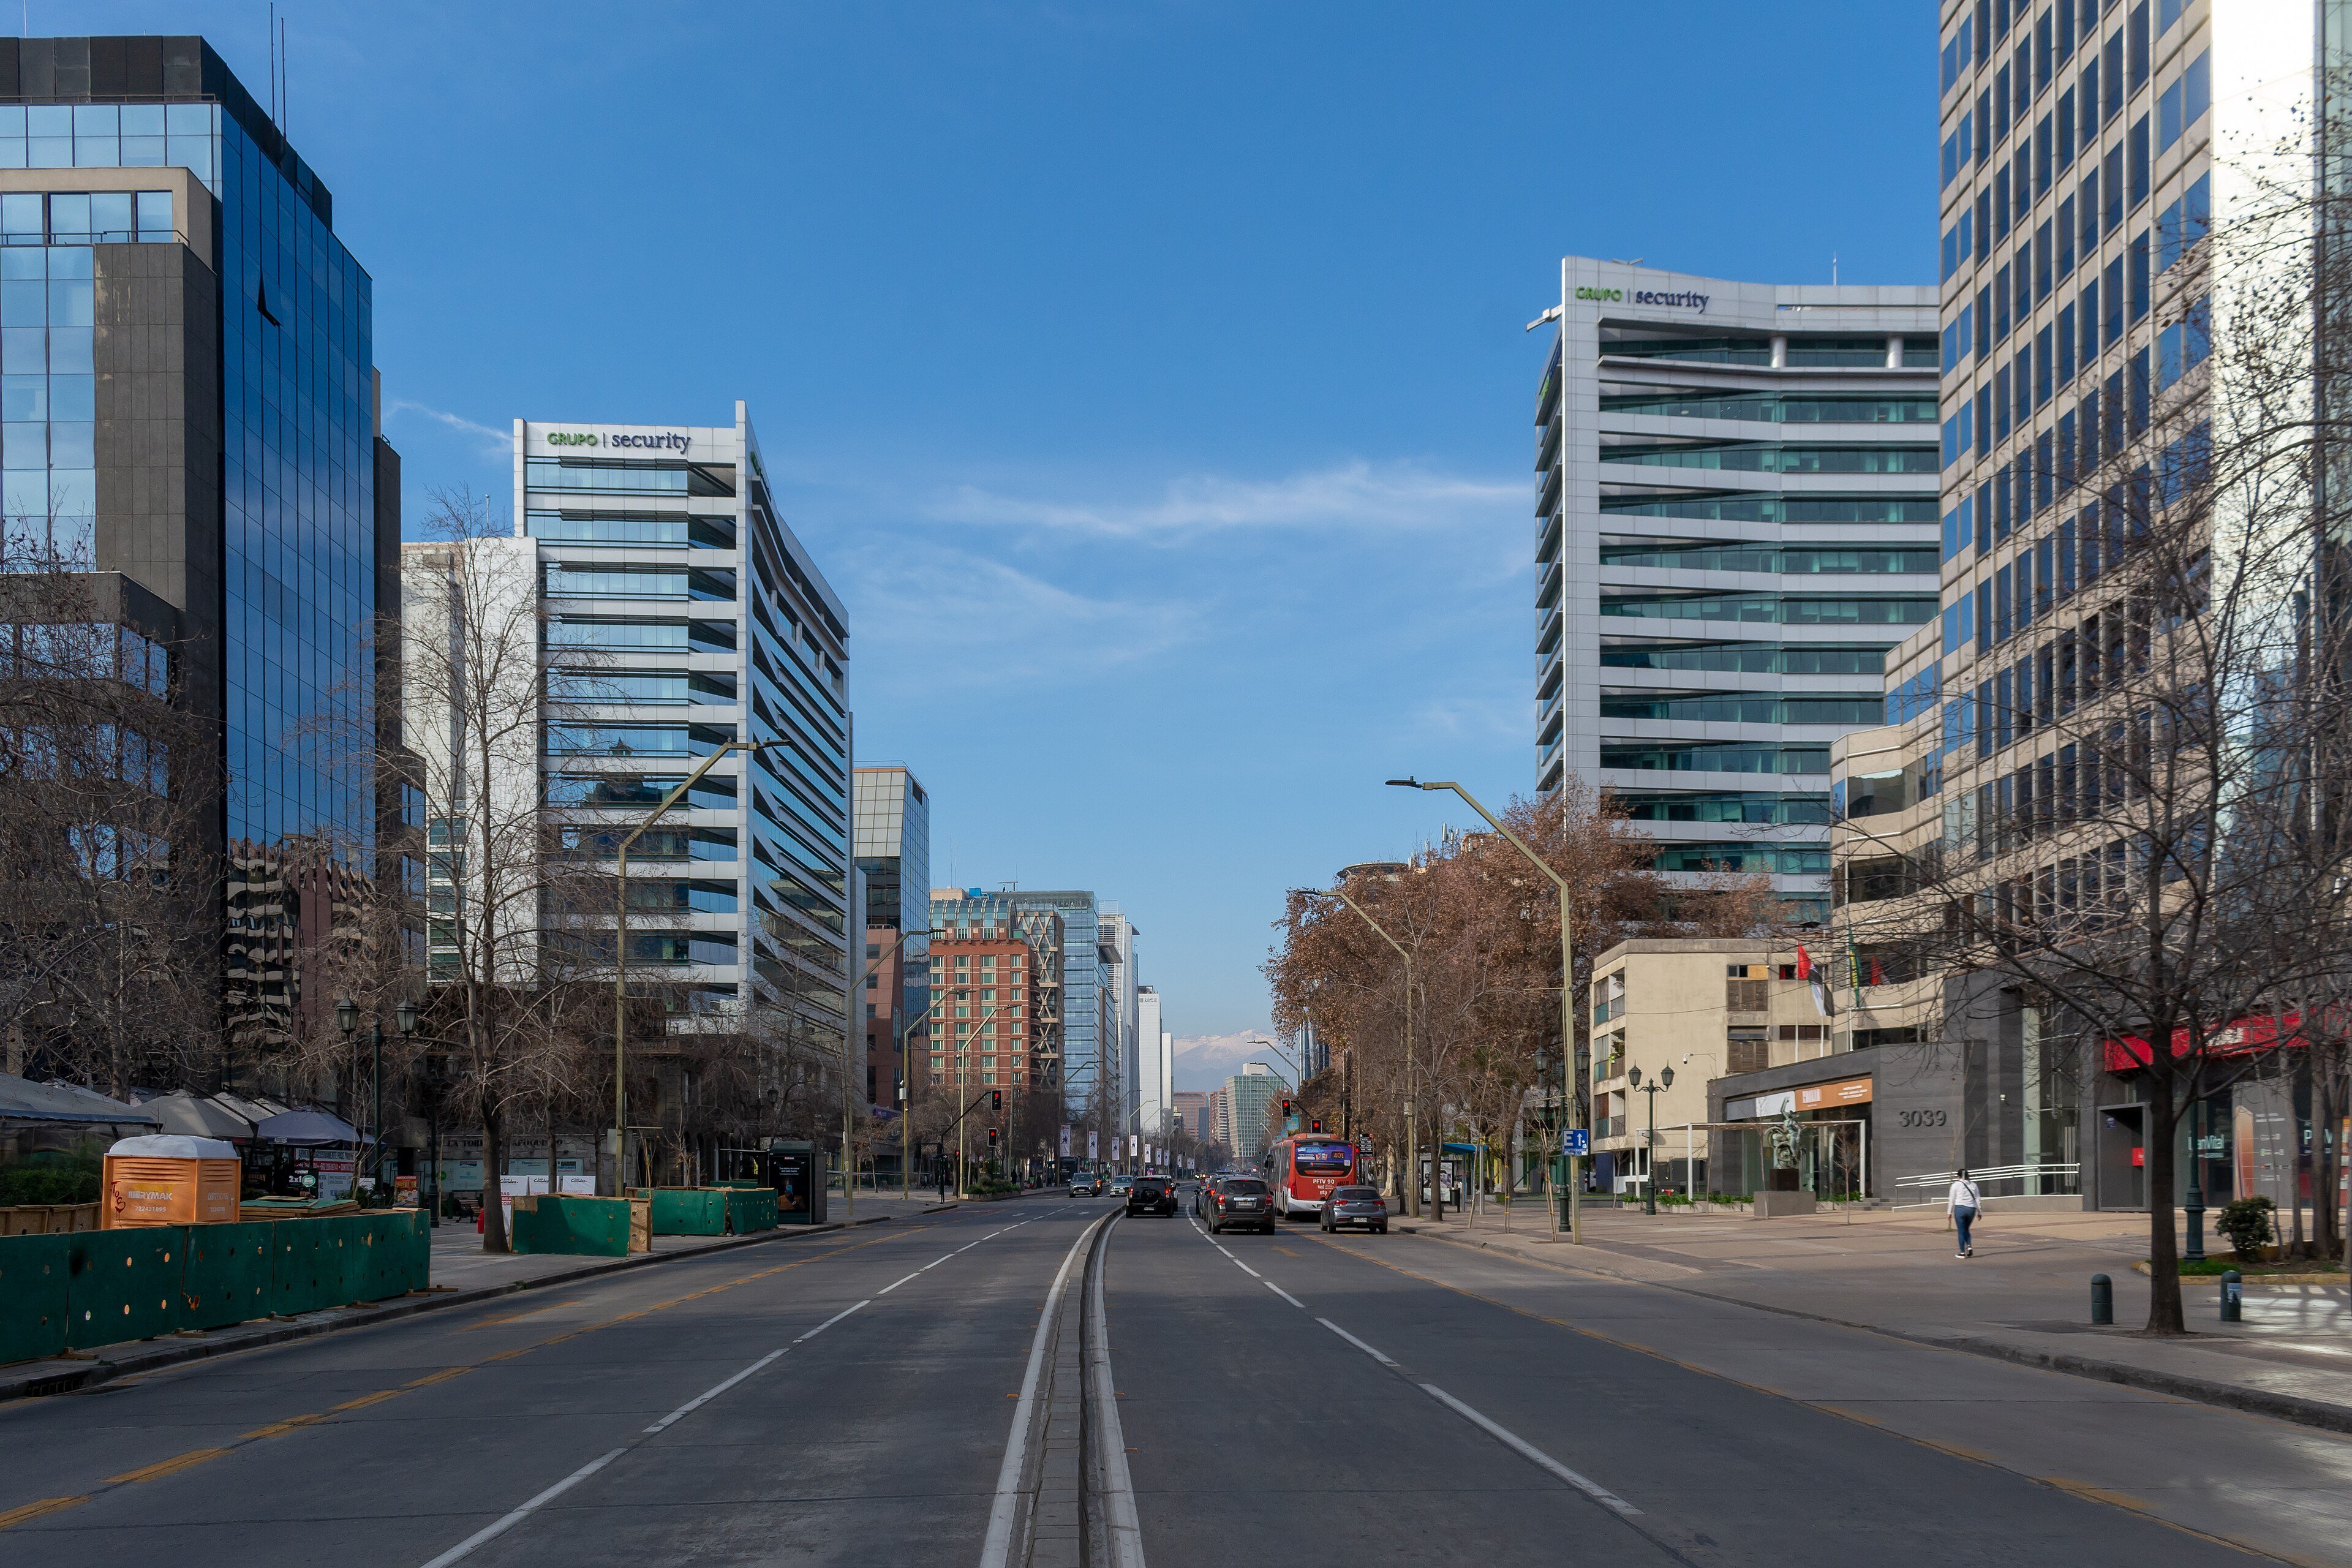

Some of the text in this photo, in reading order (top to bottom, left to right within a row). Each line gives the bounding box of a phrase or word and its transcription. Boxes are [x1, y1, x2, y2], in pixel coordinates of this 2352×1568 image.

[1575, 285, 1710, 314] GRUPO security
[547, 431, 691, 454] GRUPO security
[1899, 1110, 1947, 1128] 3039
[1564, 1131, 1574, 1147] E
